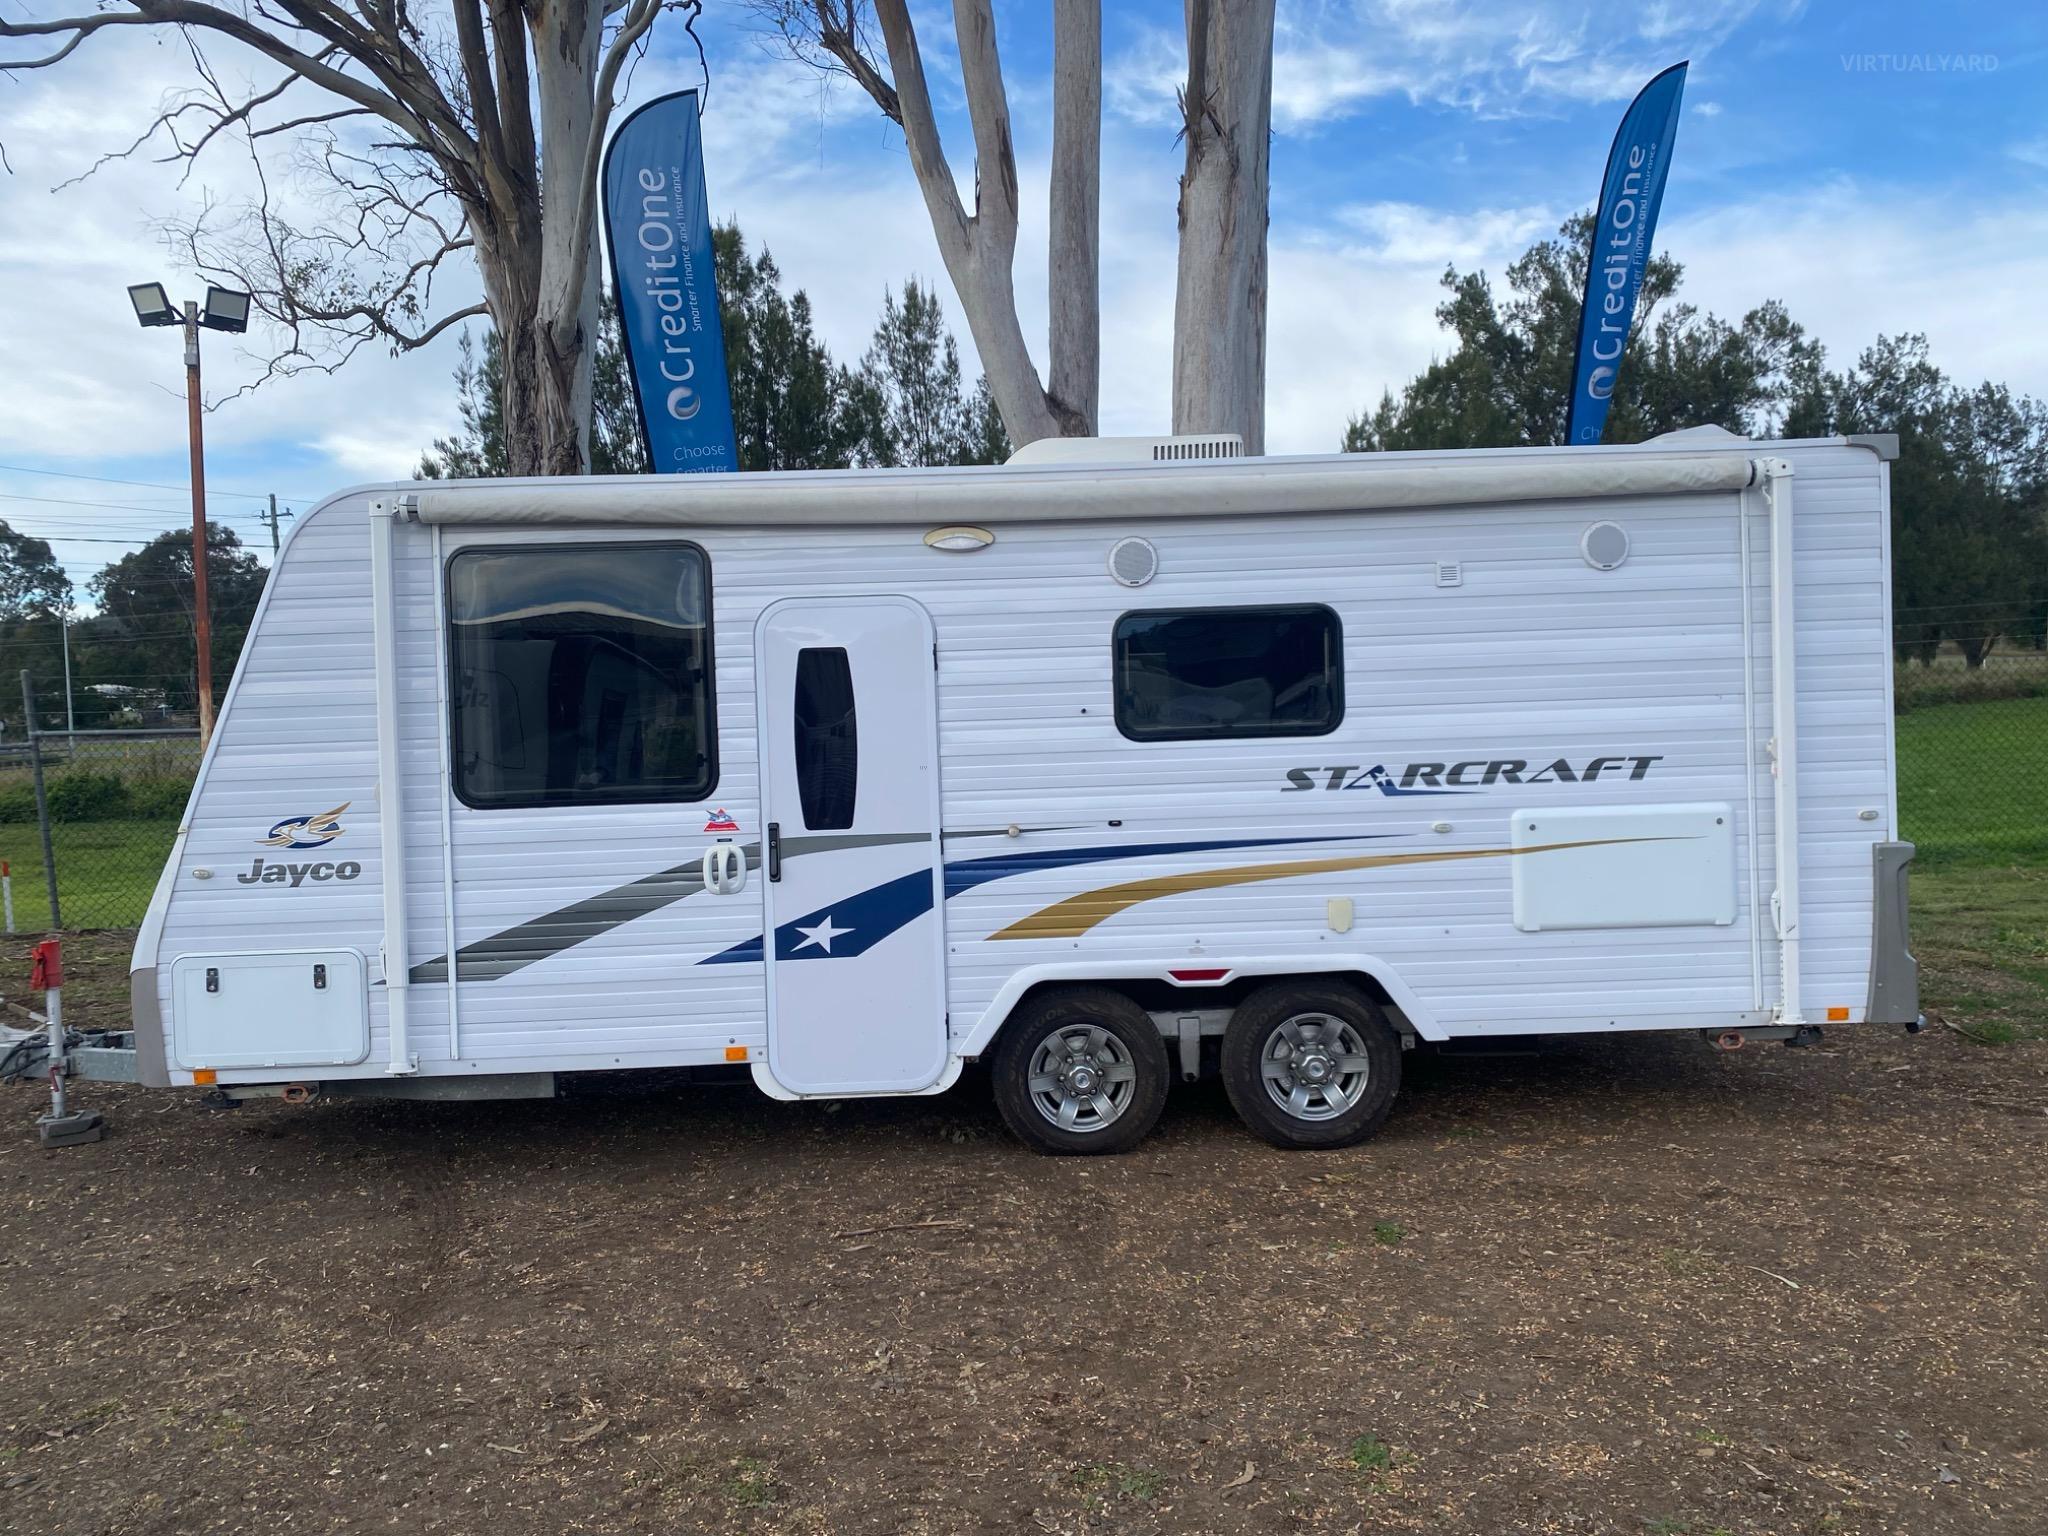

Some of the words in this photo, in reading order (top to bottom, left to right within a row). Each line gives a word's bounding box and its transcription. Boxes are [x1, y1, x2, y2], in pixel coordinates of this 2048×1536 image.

[1641, 142, 1657, 196] Insurance
[671, 166, 684, 220] Insurance
[1639, 199, 1648, 220] and
[676, 222, 689, 243] and
[1593, 145, 1646, 361] CreditOne
[1633, 223, 1646, 265] Finance
[638, 168, 695, 382] CreditOne
[681, 245, 695, 286] Finance
[688, 290, 702, 332] Smarter
[673, 444, 726, 461] Choose
[1280, 755, 1664, 795] STARCRAFT
[237, 858, 361, 887] Jayco
